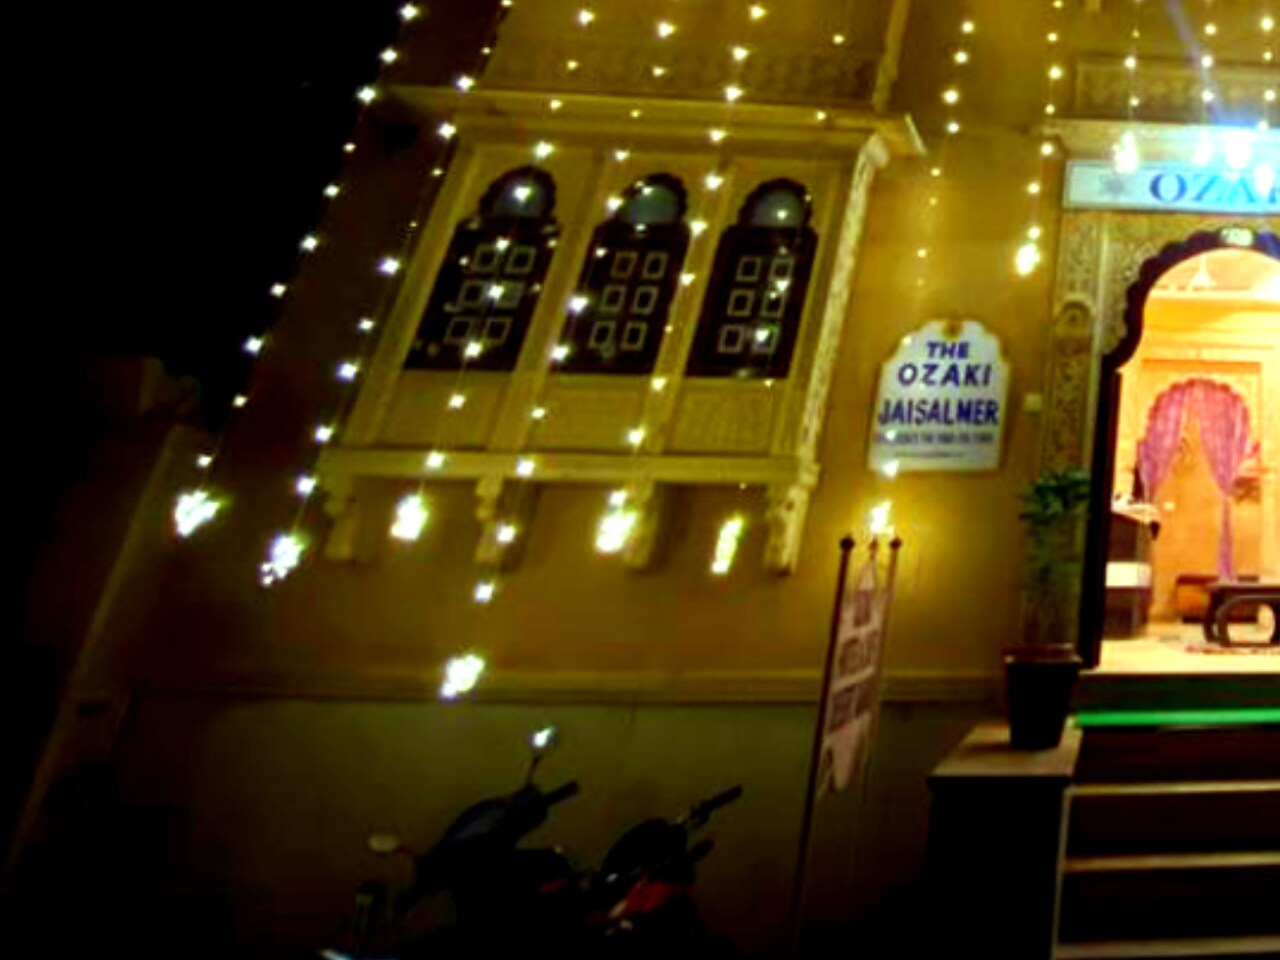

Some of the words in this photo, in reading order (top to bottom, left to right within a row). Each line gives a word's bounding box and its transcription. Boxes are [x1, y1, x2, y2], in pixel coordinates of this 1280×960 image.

[927, 342, 969, 359] THE
[898, 363, 992, 386] OZAKI
[878, 398, 999, 425] JAISALMER
